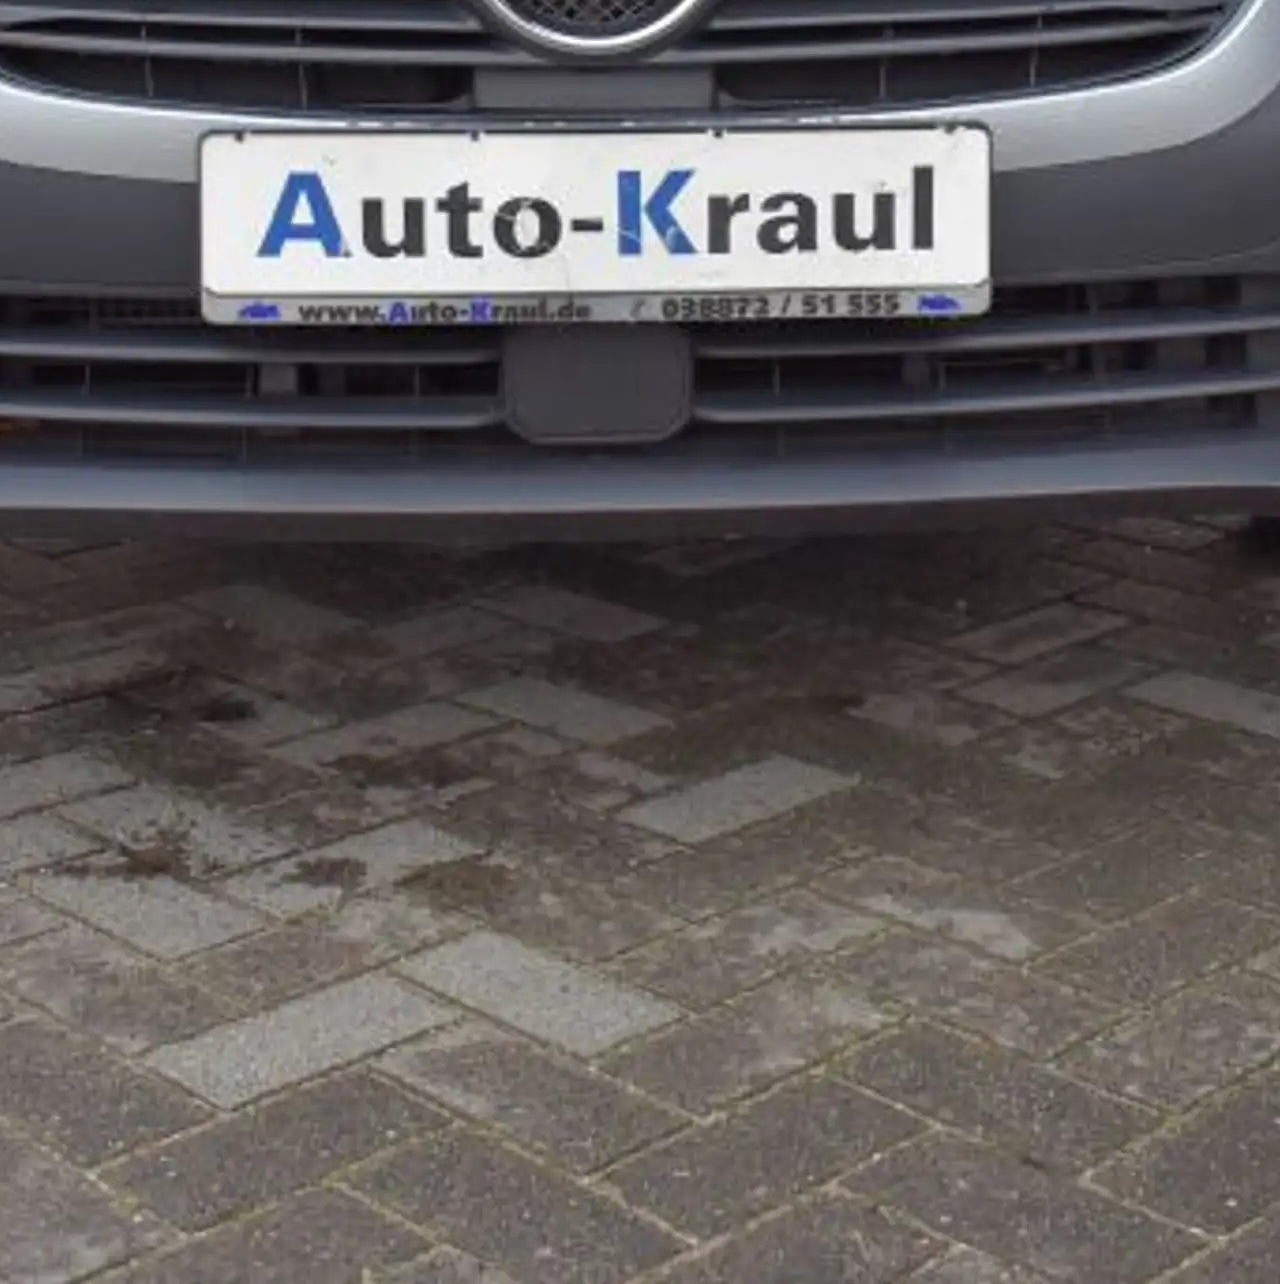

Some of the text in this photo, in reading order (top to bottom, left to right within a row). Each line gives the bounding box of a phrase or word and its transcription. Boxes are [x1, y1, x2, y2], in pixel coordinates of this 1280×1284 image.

[257, 166, 935, 259] Auto-Kraul
[298, 296, 591, 324] www.Auto-Kraul.de
[801, 294, 834, 316] 51
[846, 293, 901, 315] 555
